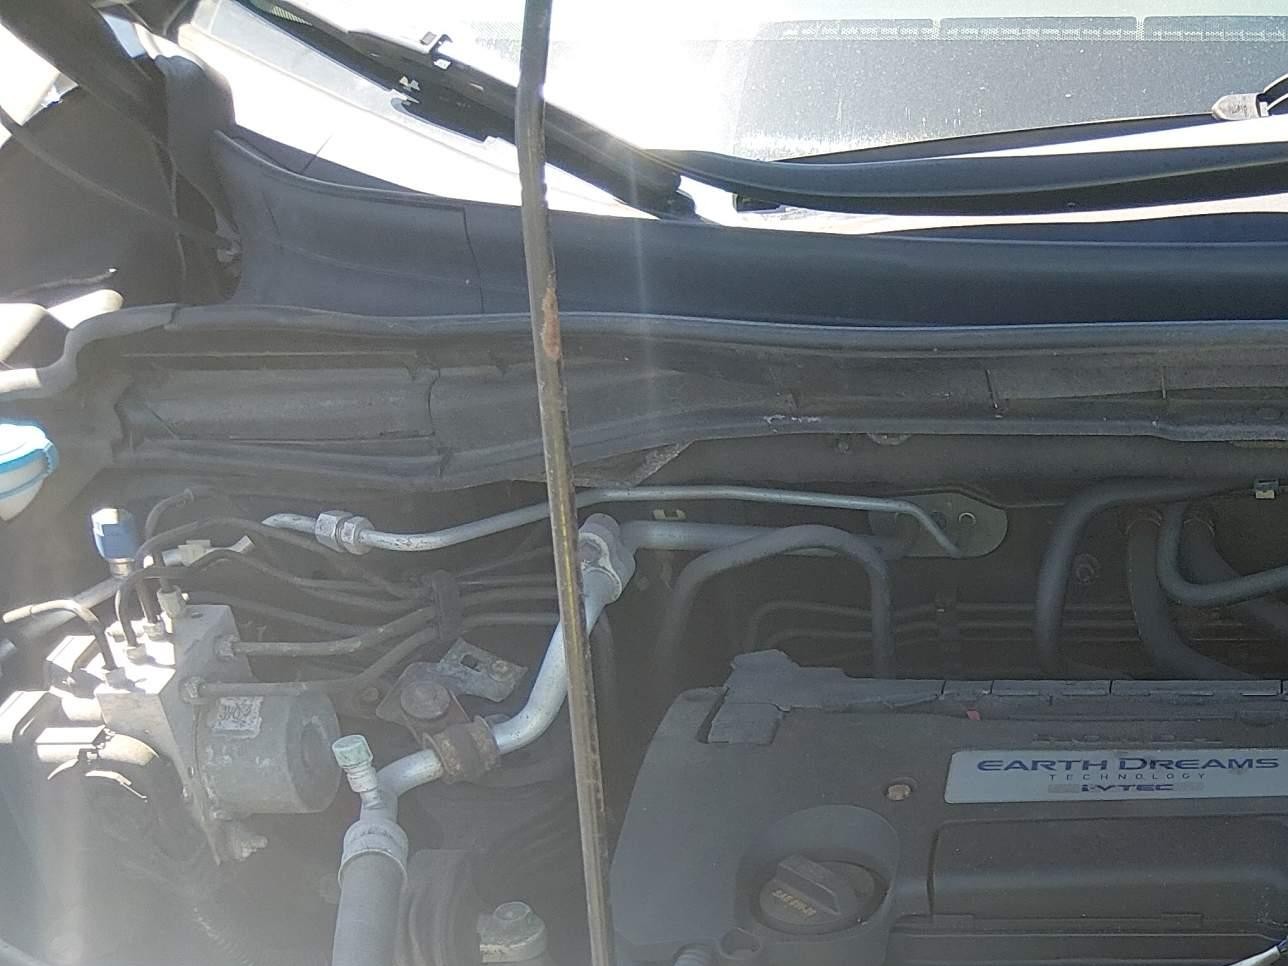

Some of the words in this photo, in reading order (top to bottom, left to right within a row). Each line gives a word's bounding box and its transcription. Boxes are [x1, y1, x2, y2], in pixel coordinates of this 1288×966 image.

[976, 759, 1108, 771] EARTH
[1118, 757, 1280, 769] DREAMS
[1049, 773, 1207, 781] TECHNOLOGY
[1081, 783, 1175, 792] i-VTEC
